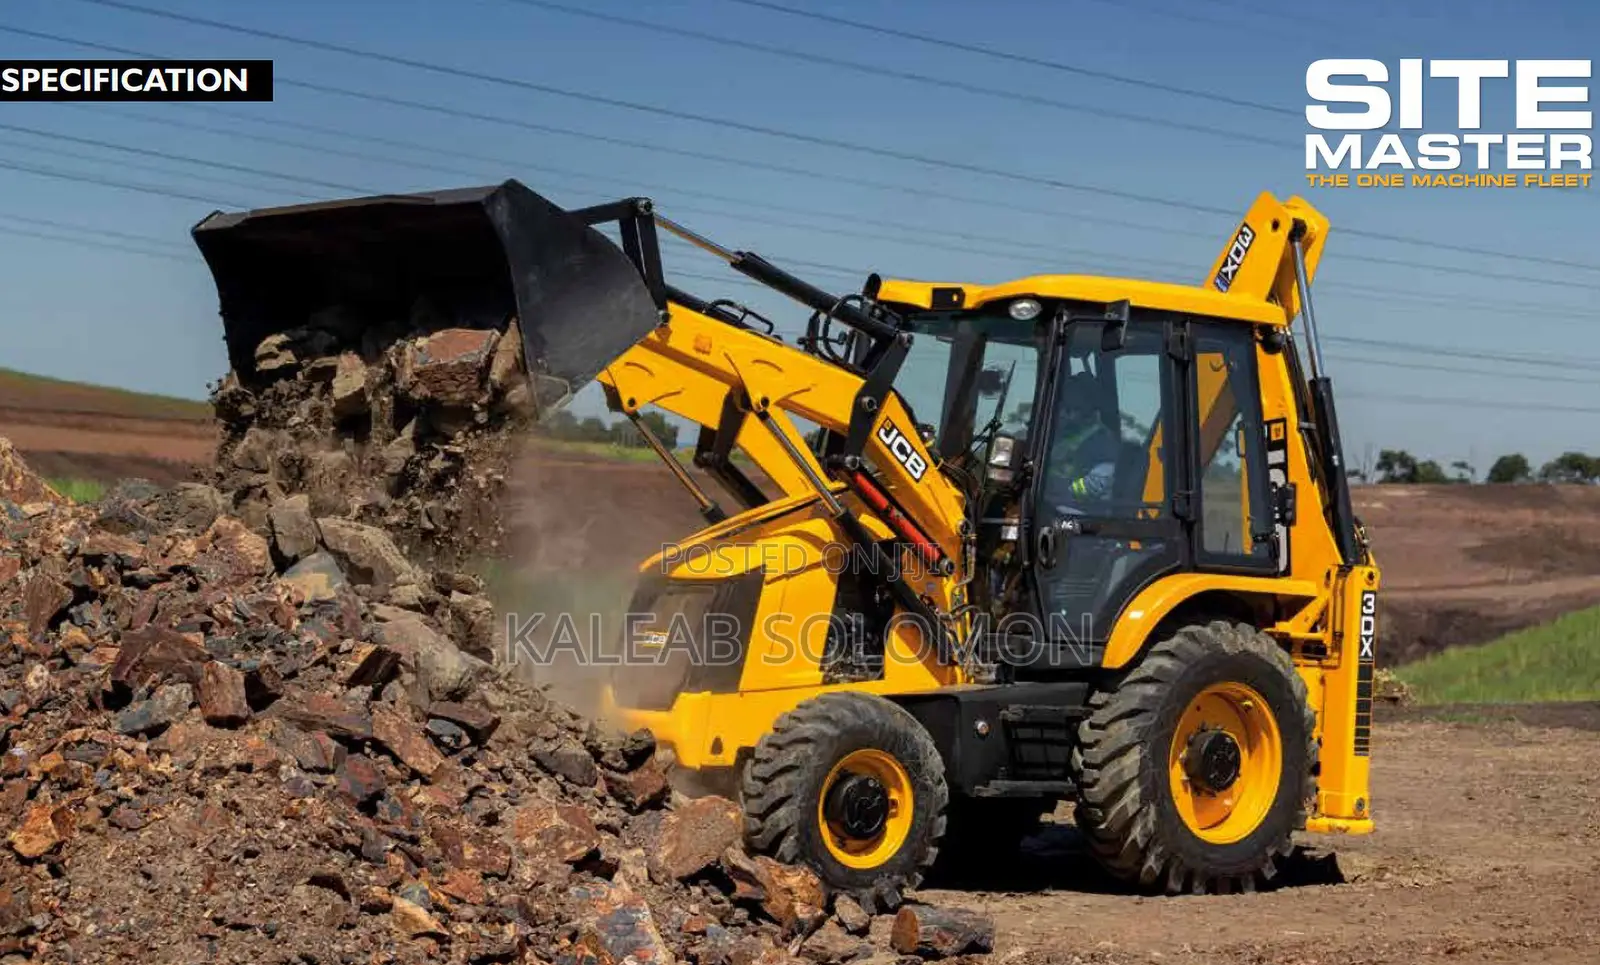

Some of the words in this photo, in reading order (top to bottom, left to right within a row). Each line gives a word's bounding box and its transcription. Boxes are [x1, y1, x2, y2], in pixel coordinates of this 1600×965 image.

[1220, 226, 1254, 281] 3DX
[878, 426, 927, 480] JCB
[1361, 593, 1375, 657] 3DX
